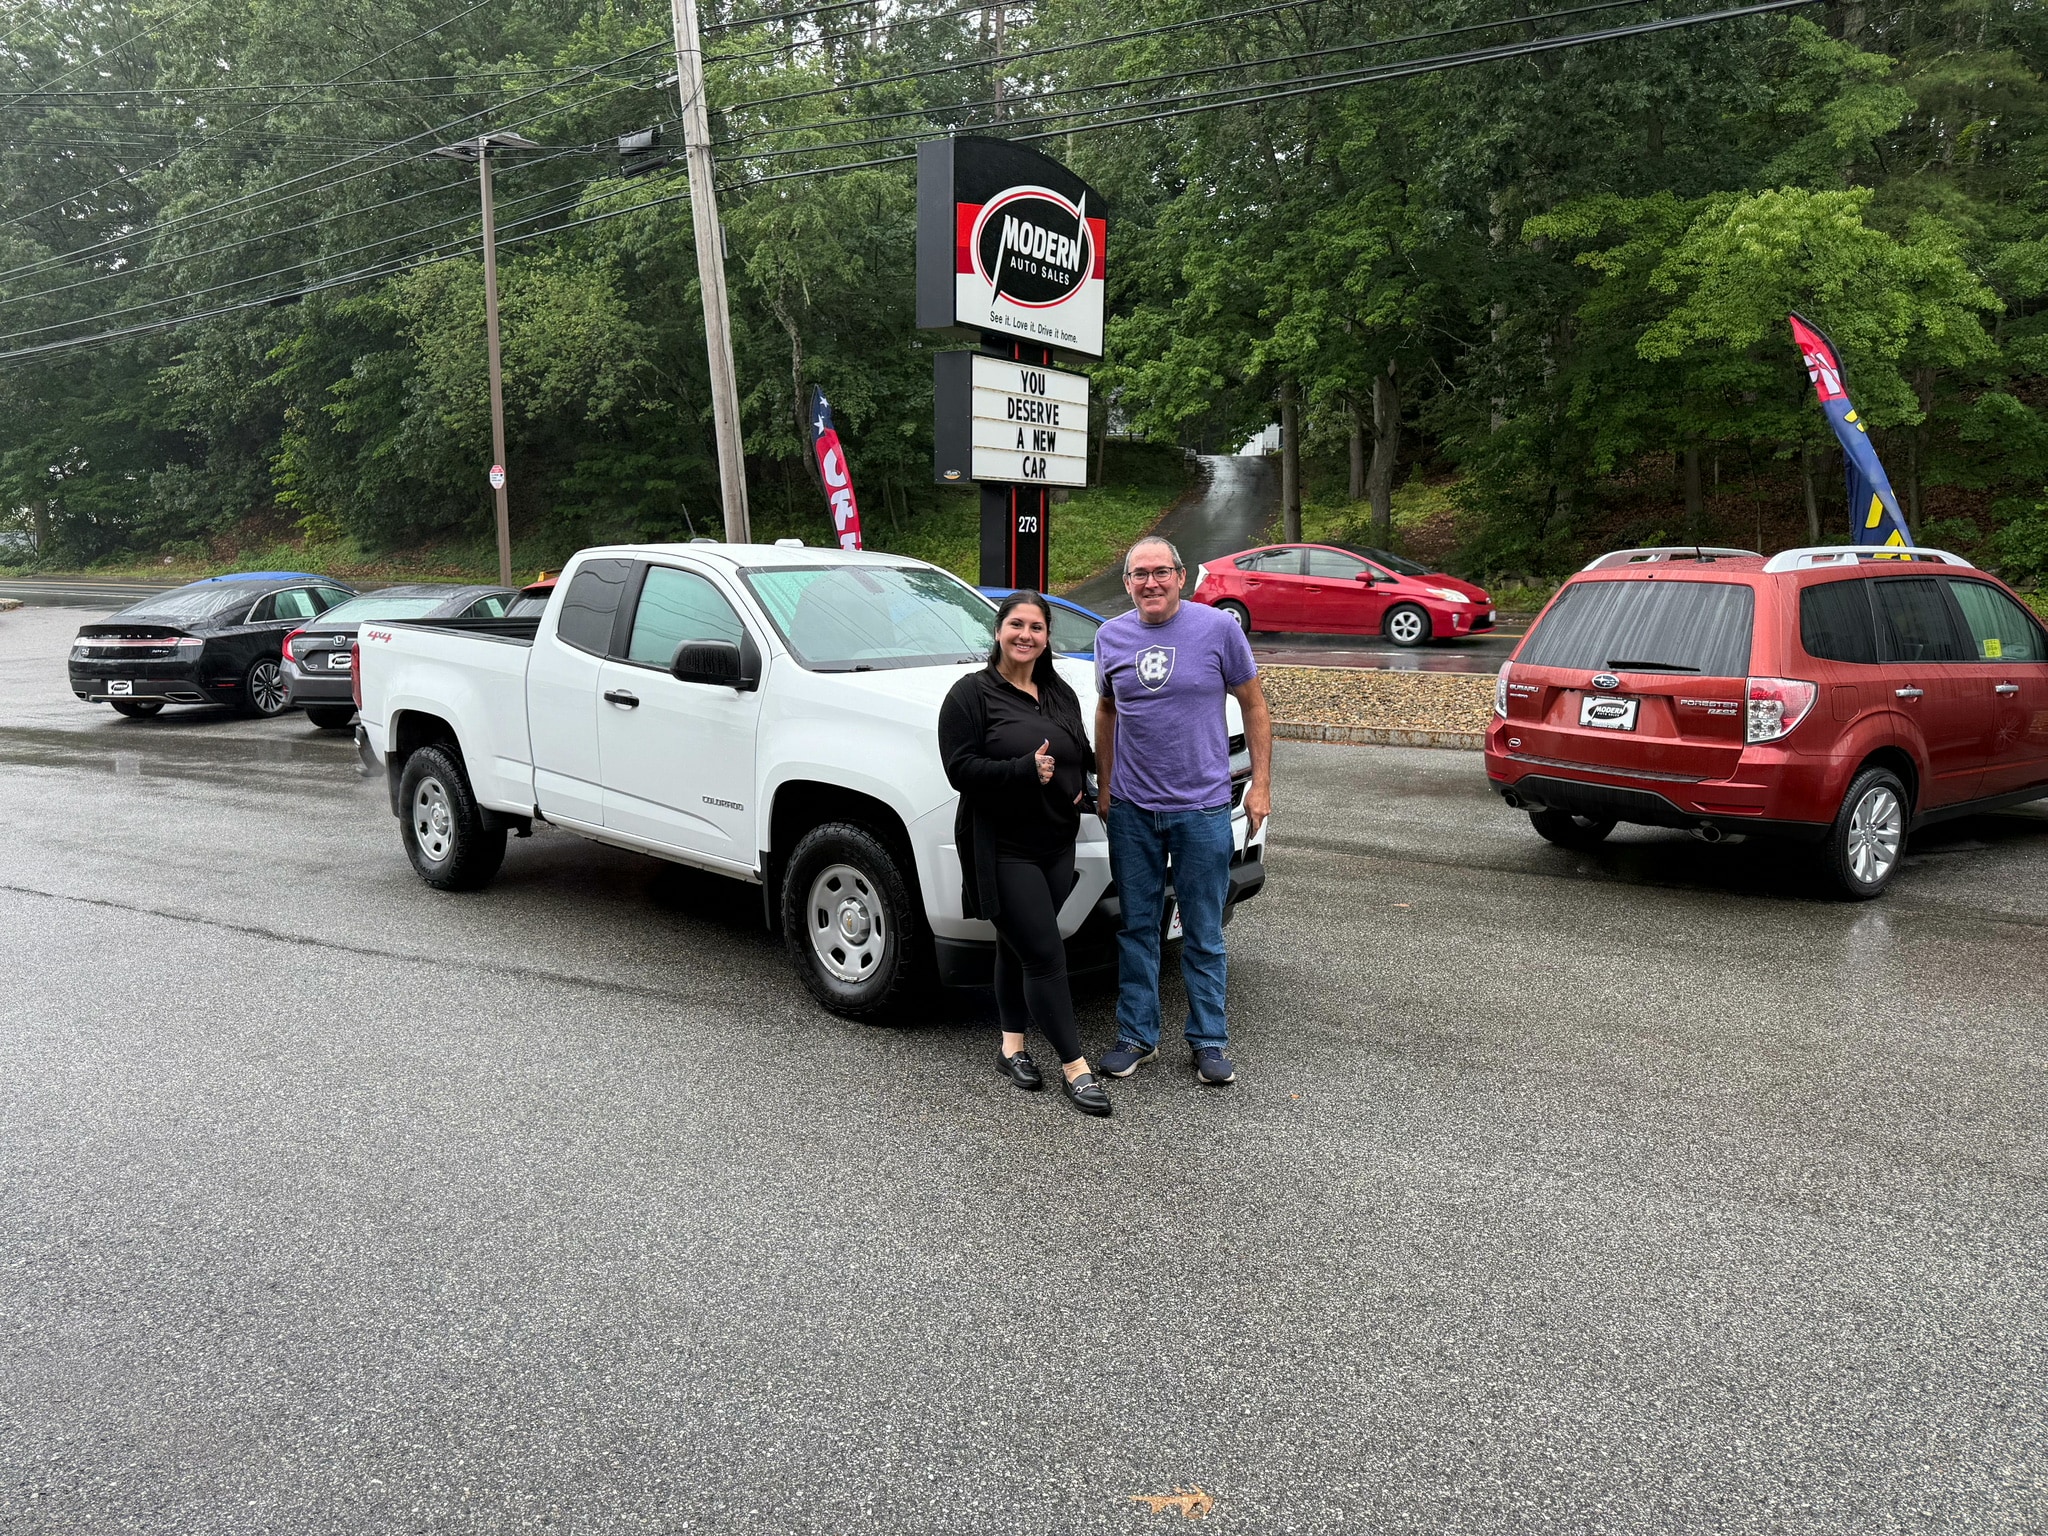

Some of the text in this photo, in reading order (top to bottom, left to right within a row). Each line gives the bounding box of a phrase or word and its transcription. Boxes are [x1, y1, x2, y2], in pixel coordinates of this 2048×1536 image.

[1010, 256, 1070, 286] AUTO SALES
[990, 310, 1003, 324] See
[1013, 316, 1028, 331] Love
[1038, 323, 1053, 337] Drive
[1054, 328, 1059, 339] it
[1061, 329, 1078, 343] home.
[1020, 369, 1045, 396] YOU
[1007, 396, 1059, 426] DESERVE
[1016, 426, 1056, 453] A NEW
[1022, 455, 1046, 479] CAR
[1018, 515, 1038, 534] 273
[1680, 699, 1739, 708] FORESTER
